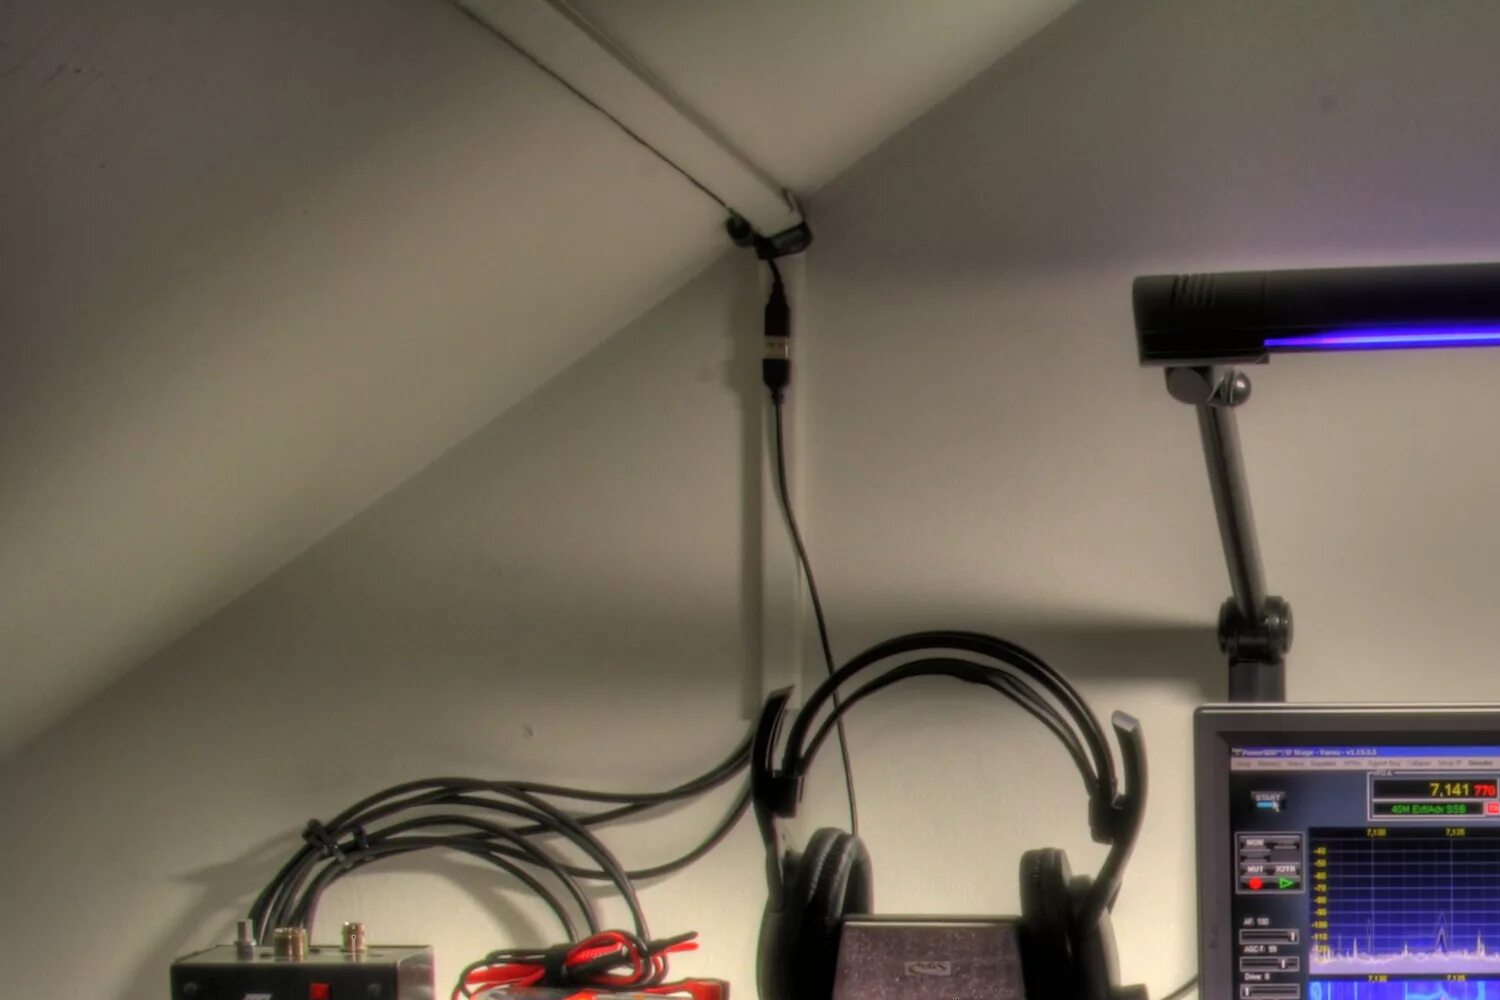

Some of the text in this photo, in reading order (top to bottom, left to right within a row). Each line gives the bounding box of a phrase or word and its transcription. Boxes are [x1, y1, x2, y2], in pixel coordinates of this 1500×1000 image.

[1430, 782, 1496, 797] 7,141 770
[1256, 794, 1280, 802] START
[1446, 804, 1466, 814] SSB
